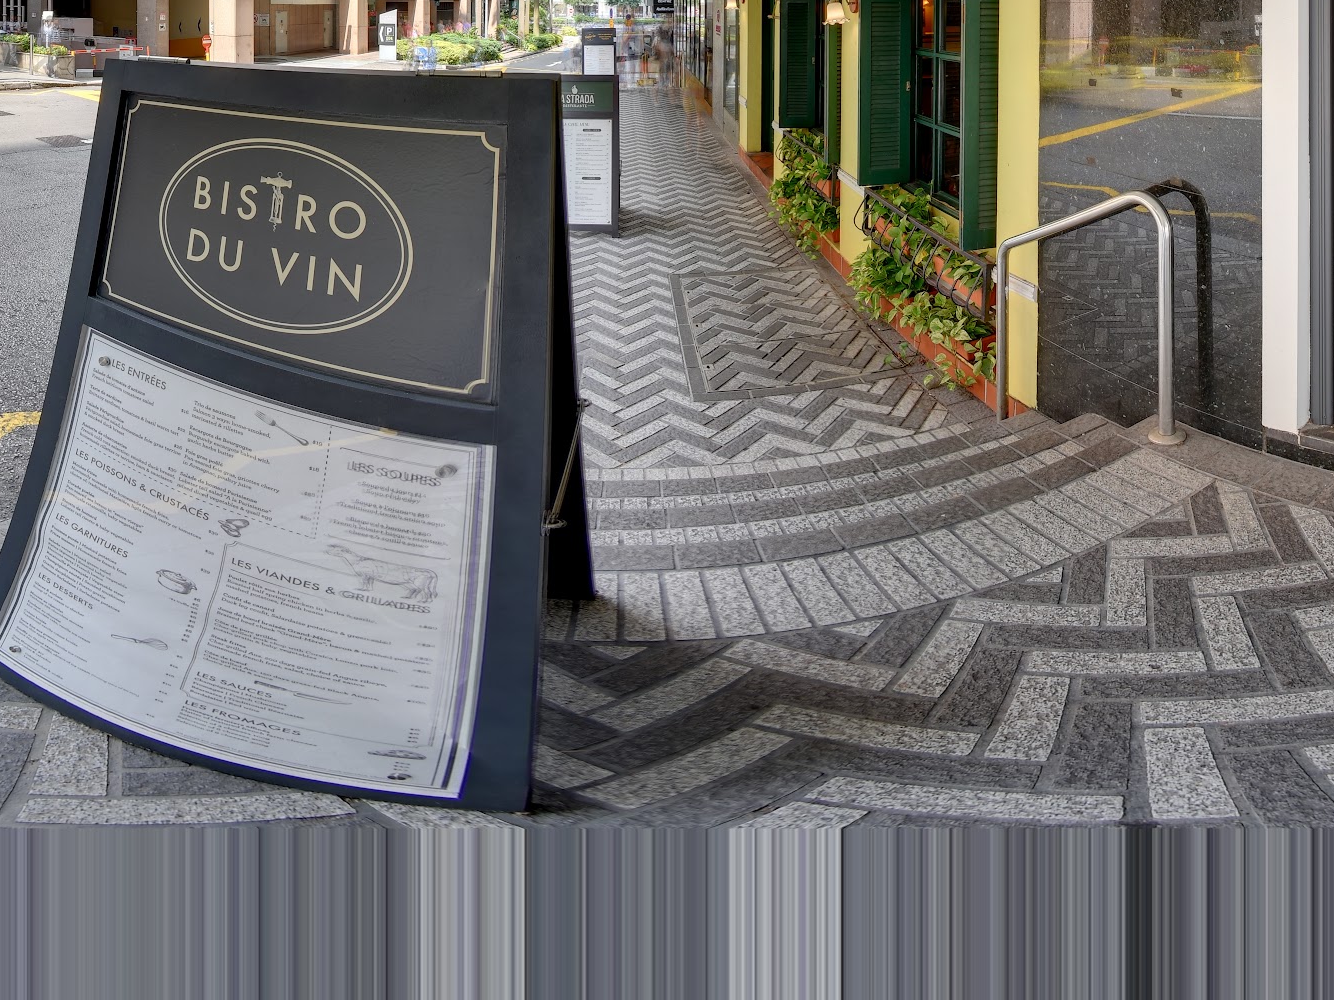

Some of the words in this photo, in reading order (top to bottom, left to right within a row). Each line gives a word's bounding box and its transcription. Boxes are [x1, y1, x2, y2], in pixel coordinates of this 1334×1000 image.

[566, 94, 595, 104] STRADA
[193, 171, 367, 240] BISTRO
[186, 227, 244, 272] DU
[271, 247, 363, 302] VIN
[111, 359, 126, 372] LES
[127, 366, 167, 391] ENTRÉES
[75, 448, 89, 461] LES
[91, 458, 137, 487] POISSONS
[139, 483, 147, 493] &
[149, 488, 210, 521] CRUSTACÉS
[55, 512, 70, 525] LES
[71, 522, 129, 558] GARNITURES
[38, 573, 52, 584] LES
[53, 581, 93, 610] DESSERTS
[231, 557, 252, 571] LES
[256, 565, 320, 591] VIANDES
[325, 586, 336, 596] &
[196, 671, 217, 682] LES
[220, 677, 273, 698] SAUCES
[184, 699, 207, 713] LES
[211, 707, 302, 736] FROMAGES
